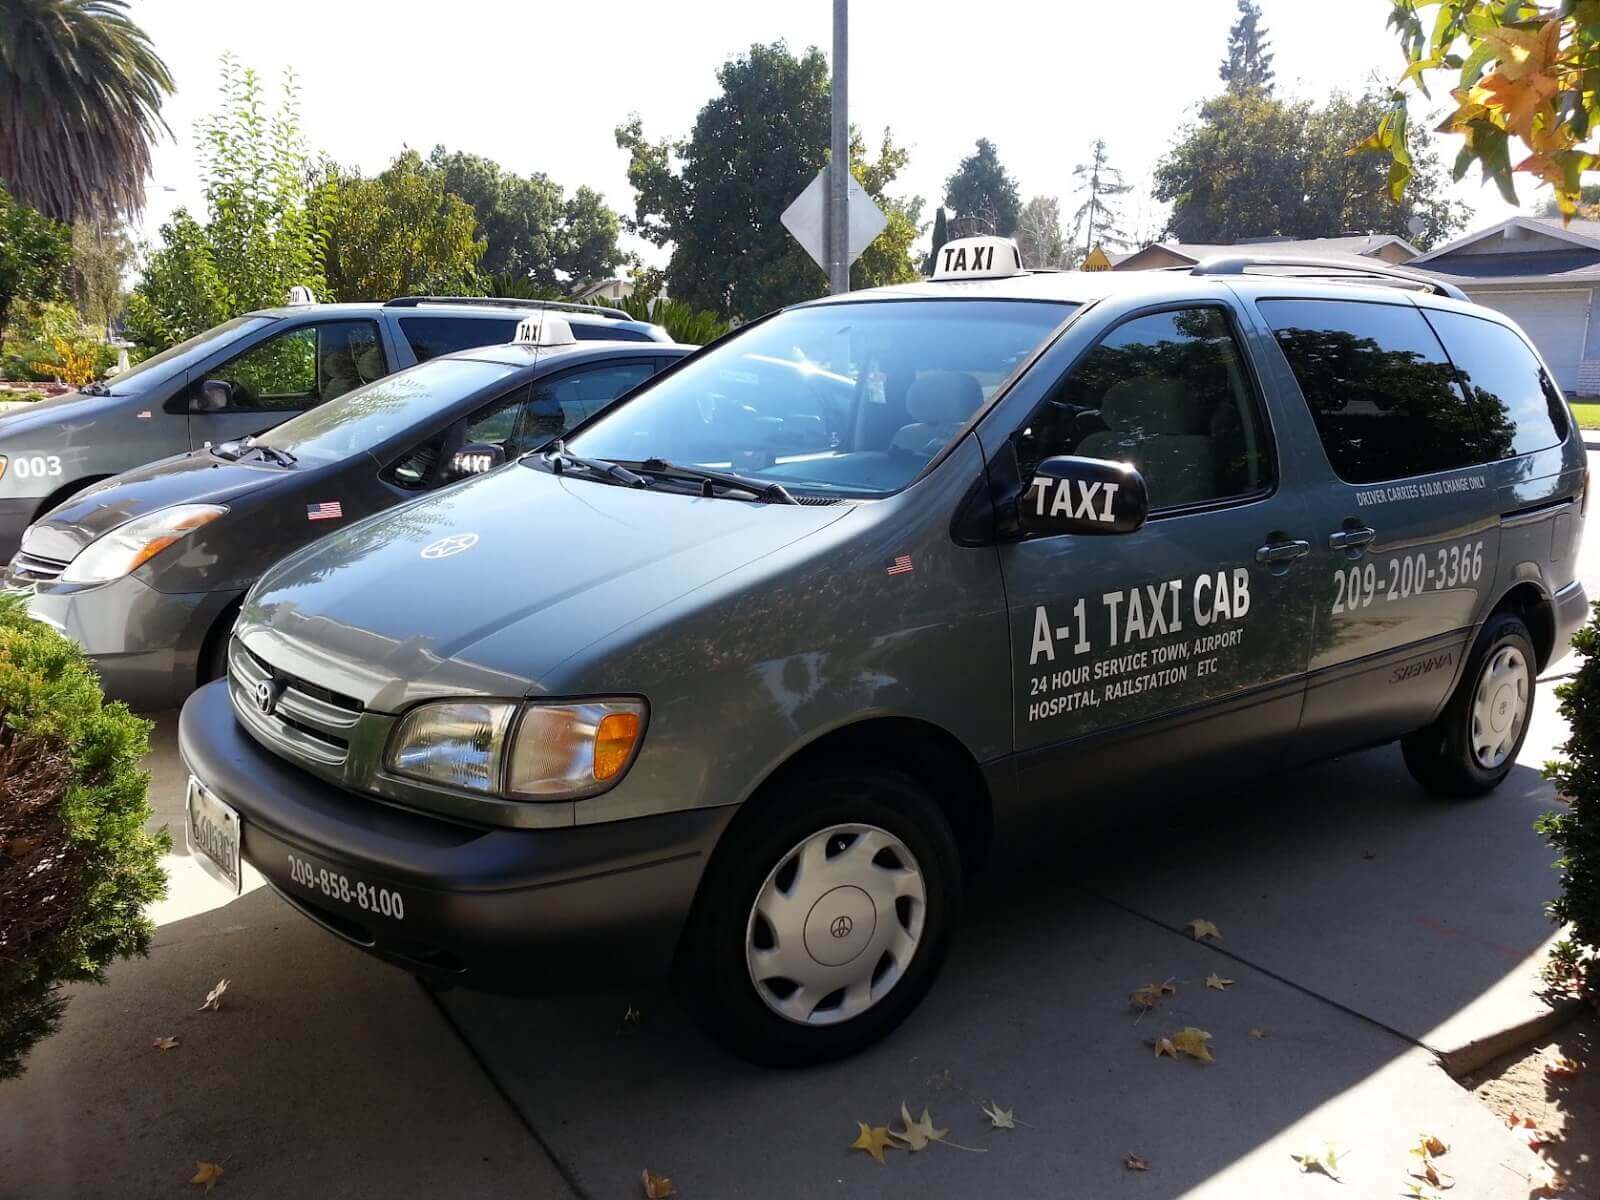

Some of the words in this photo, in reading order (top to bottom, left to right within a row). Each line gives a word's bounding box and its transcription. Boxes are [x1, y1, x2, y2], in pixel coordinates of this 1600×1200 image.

[944, 246, 994, 272] TAXI
[521, 324, 542, 341] TAXI
[14, 455, 62, 478] 003
[1356, 490, 1388, 506] DRIVER
[1387, 486, 1419, 502] CARRIES
[1420, 482, 1443, 498] $10.00
[1443, 478, 1470, 494] CHANGE
[1469, 475, 1487, 490] ONLY
[1032, 476, 1119, 523] TAXI
[1331, 541, 1484, 615] 209-200-3366
[1029, 598, 1091, 665] A-1
[1103, 579, 1183, 647] TAXI
[1193, 567, 1251, 627] CAB
[1028, 694, 1101, 722] HOSPITAL,
[1104, 665, 1188, 701] RAILSTATION
[1196, 657, 1218, 677] ETC
[1030, 676, 1047, 696] 24
[1052, 665, 1090, 690] HOUR
[1094, 651, 1147, 680] SERVICE
[1151, 641, 1191, 665] TOWN,
[1193, 628, 1244, 655] AIRPORT
[287, 855, 405, 921] 209-858-8100
